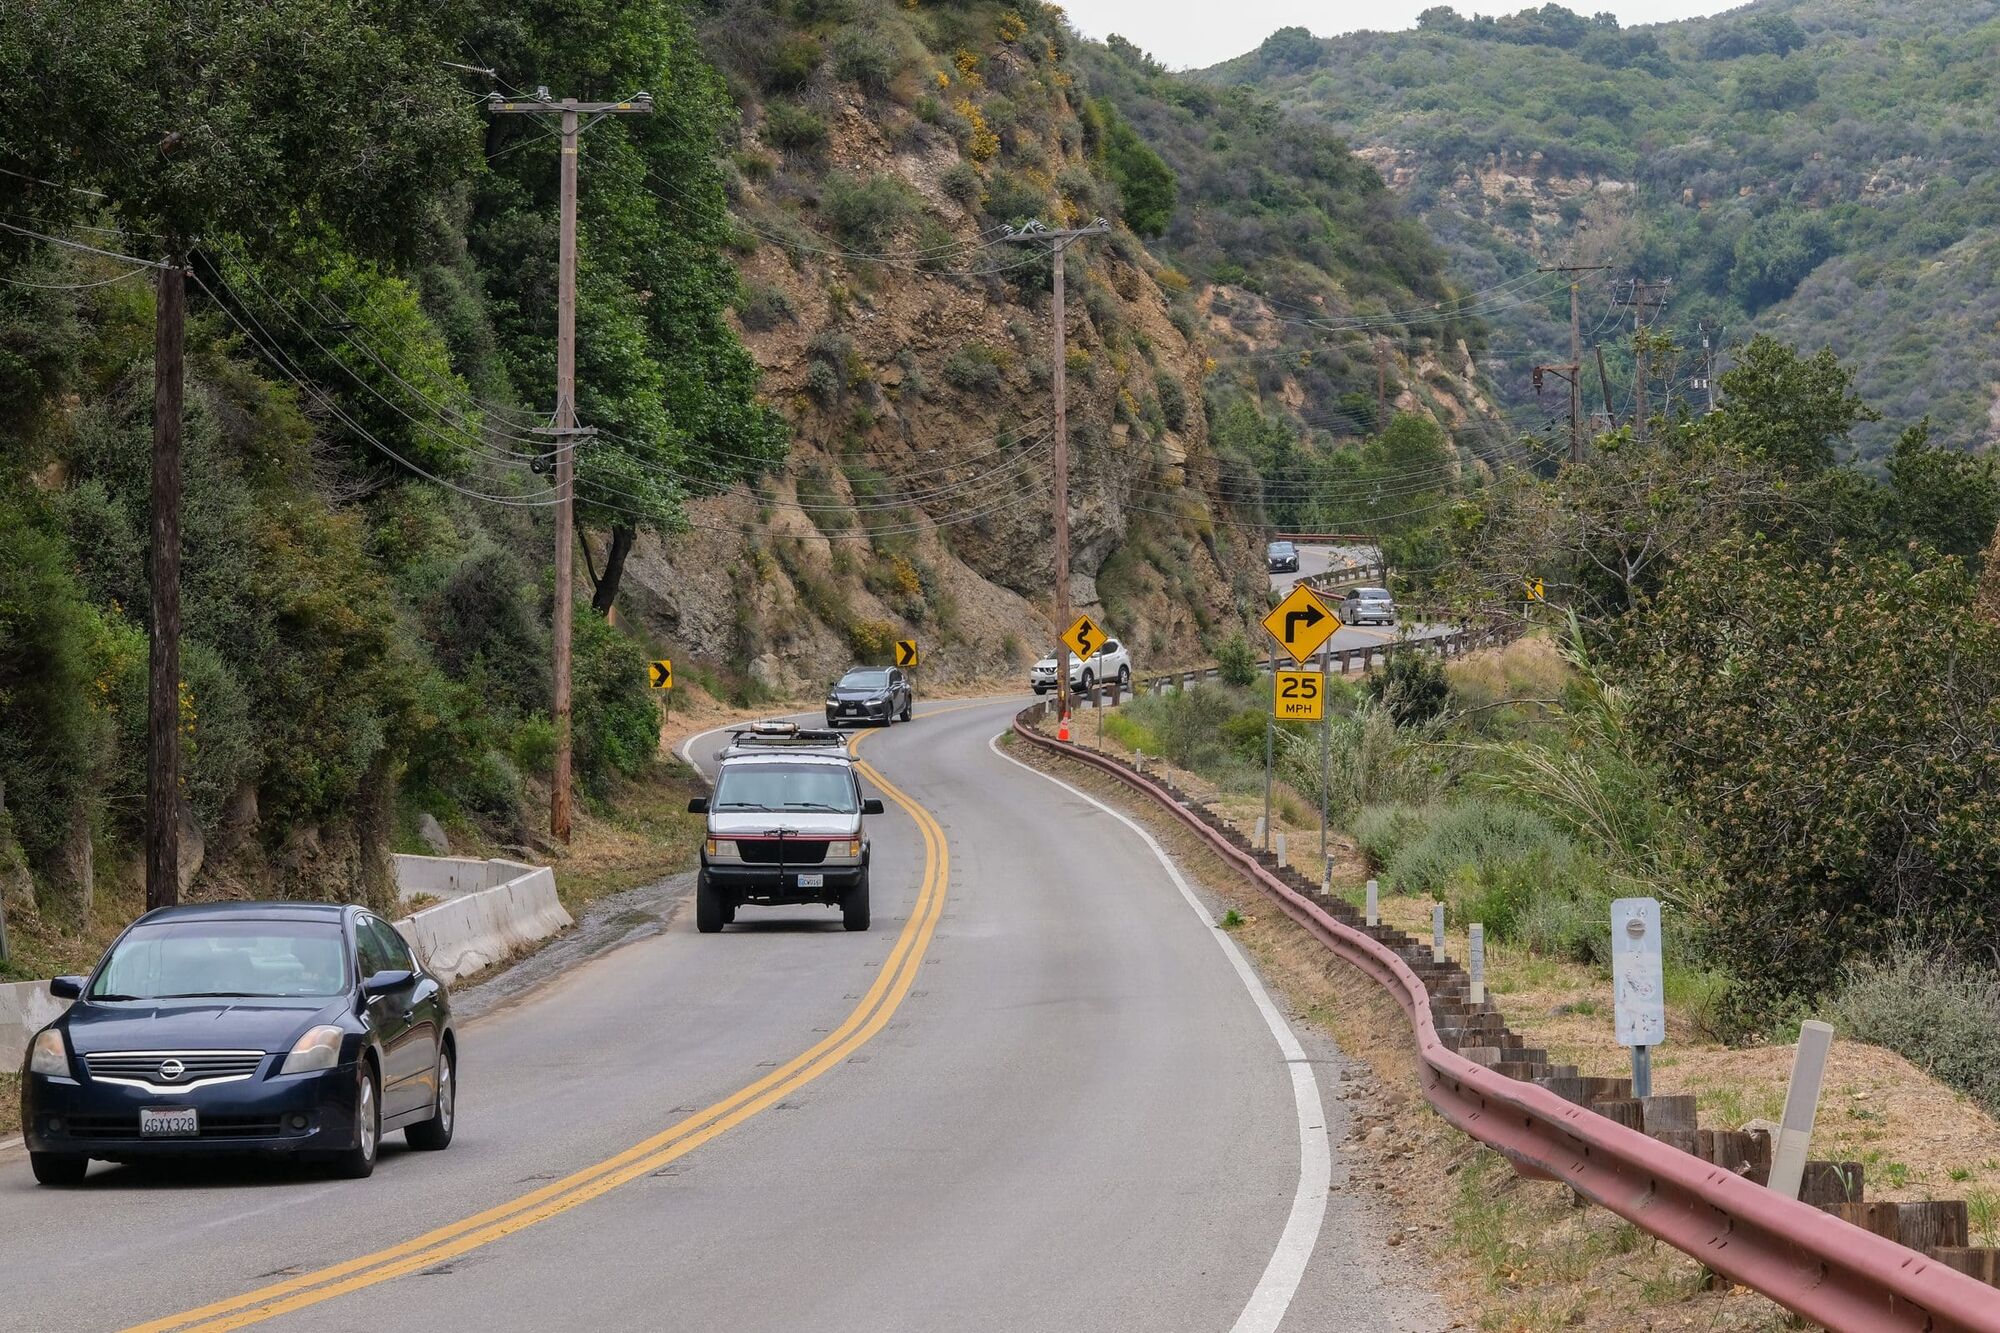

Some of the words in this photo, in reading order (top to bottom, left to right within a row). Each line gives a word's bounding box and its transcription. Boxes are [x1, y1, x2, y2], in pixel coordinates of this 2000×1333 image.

[1282, 677, 1317, 699] 25
[1285, 704, 1312, 713] MPH
[144, 1117, 195, 1132] 6GXX328
